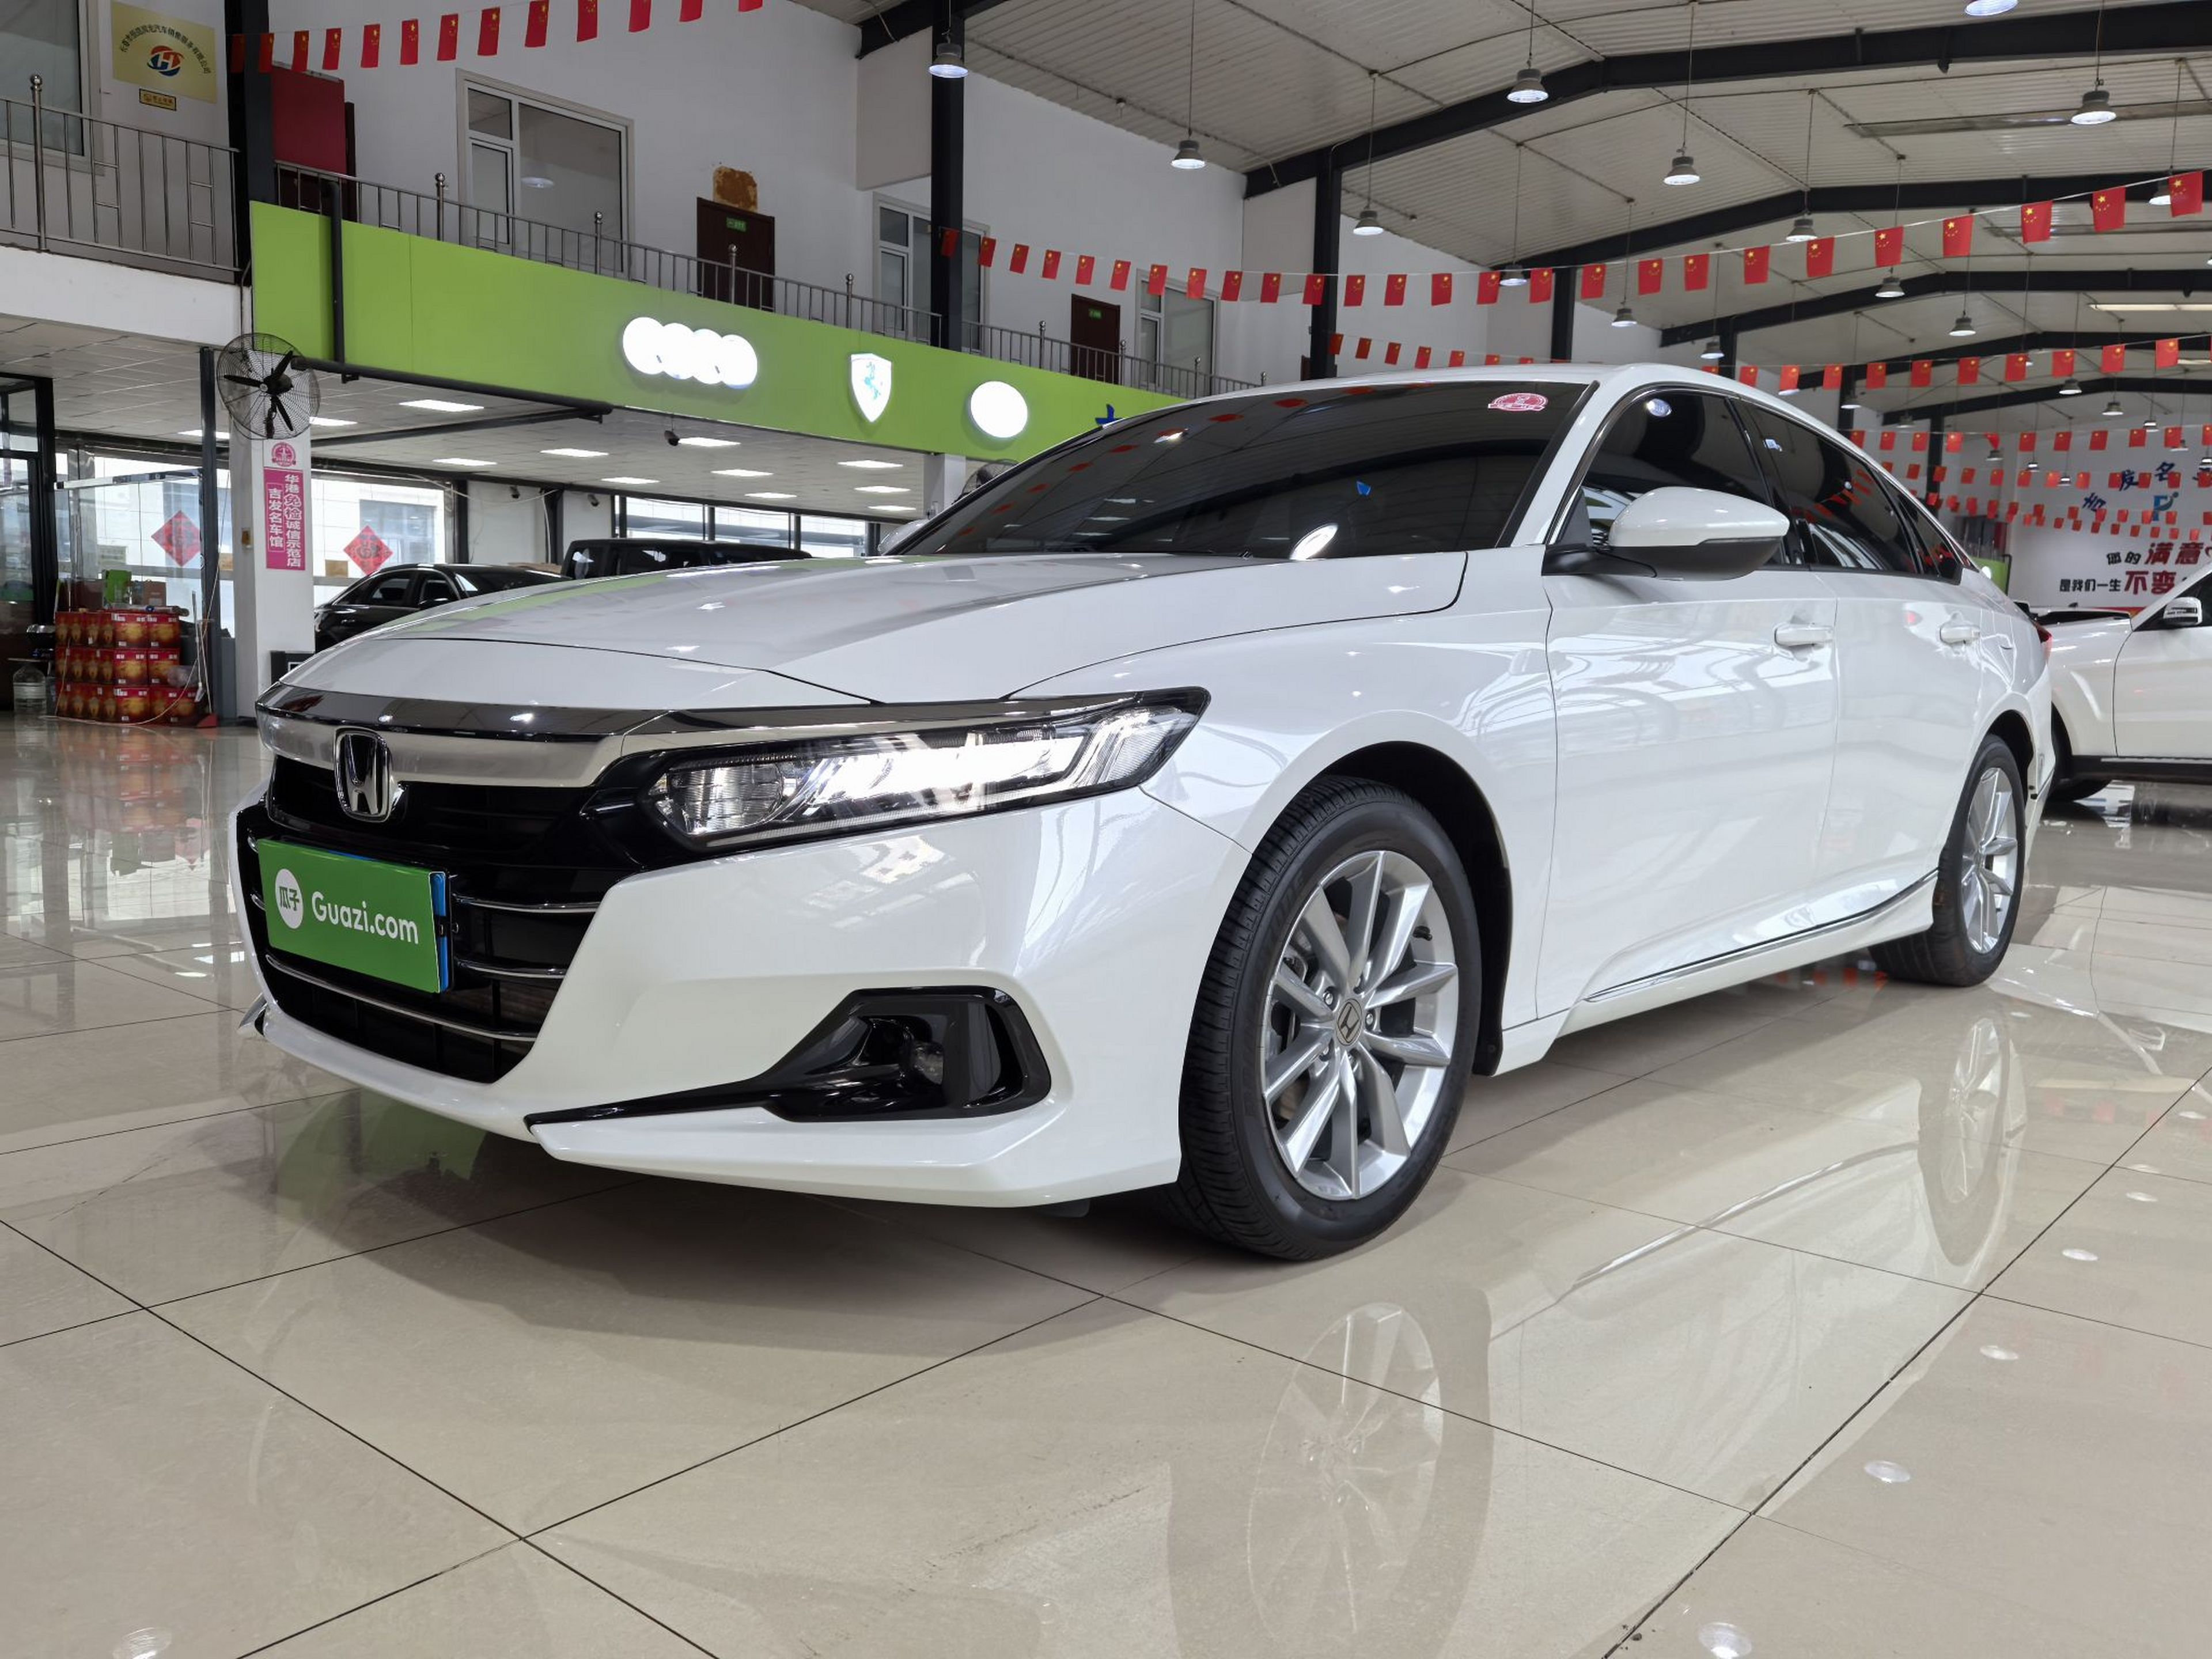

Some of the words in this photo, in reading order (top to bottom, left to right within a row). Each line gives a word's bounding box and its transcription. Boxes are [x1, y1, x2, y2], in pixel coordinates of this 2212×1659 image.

[268, 488, 284, 548] 吉发名车馆
[2059, 570, 2188, 594] 是我们一生不变
[279, 886, 300, 911] 瓜子
[312, 891, 419, 945] Guazi.com
